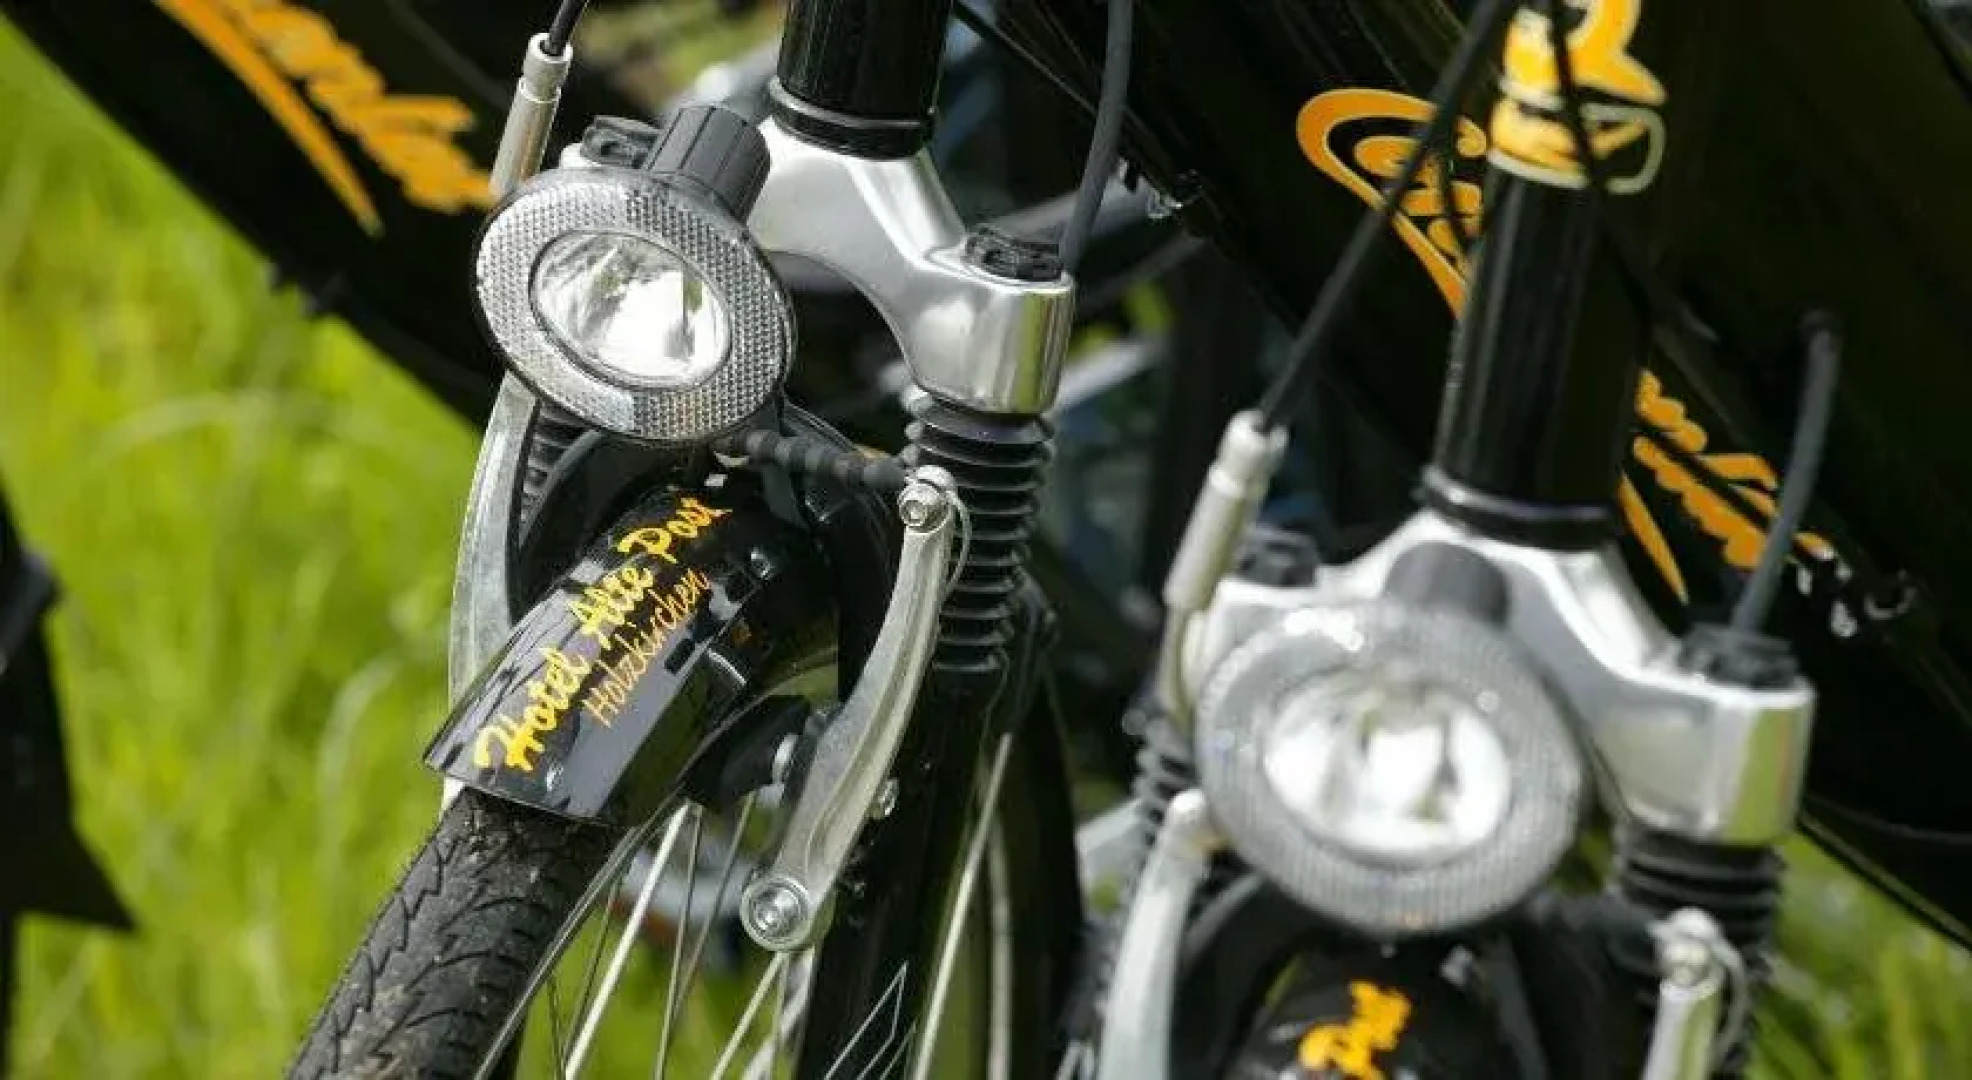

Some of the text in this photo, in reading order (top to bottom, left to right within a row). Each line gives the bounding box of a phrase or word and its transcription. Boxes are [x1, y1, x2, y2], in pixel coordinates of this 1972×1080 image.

[474, 496, 734, 773] Hotel Alte Post
[583, 567, 711, 728] Holzkirchen
